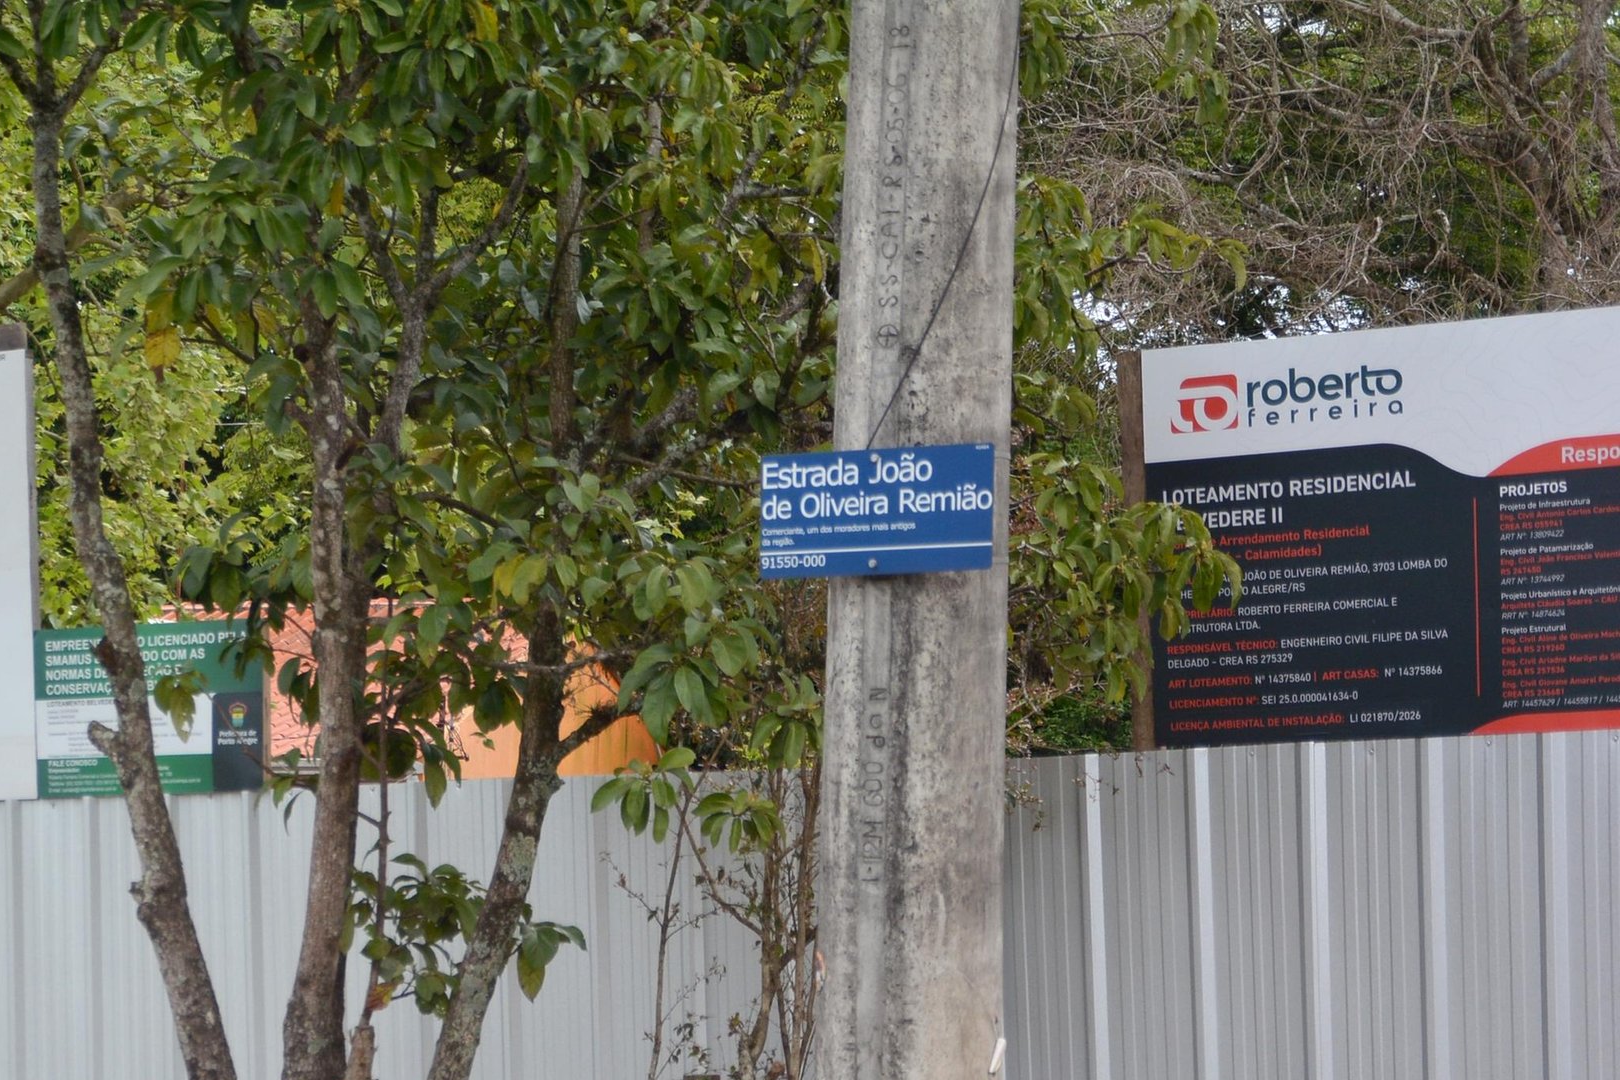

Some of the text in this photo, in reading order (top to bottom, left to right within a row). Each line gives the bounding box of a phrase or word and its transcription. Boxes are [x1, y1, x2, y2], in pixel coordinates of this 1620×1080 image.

[1246, 365, 1403, 408] roberto
[1247, 399, 1403, 428] ferreira
[761, 452, 933, 490] Estrada João
[1162, 470, 1417, 506] LOTEAMENTO RESIDENCIAL
[1499, 481, 1568, 498] PROJETOS
[762, 483, 993, 521] de Oliveira Remião
[1499, 497, 1591, 513] Projeto de Infraestrutura
[1271, 506, 1283, 524] II
[807, 527, 819, 535] um
[820, 525, 832, 534] dos
[834, 523, 870, 533] moradores
[872, 523, 889, 532] mais
[891, 521, 916, 532] antigos
[1219, 523, 1370, 547] Arrendamento Residencial
[1244, 542, 1323, 561] Calamidades)
[1500, 541, 1595, 557] Projeto de Patamarização
[761, 554, 826, 569] 91550-000
[1242, 568, 1268, 583] JOÃO
[1269, 568, 1282, 580] DE
[1284, 566, 1329, 579] OLIVEIRA
[1331, 560, 1370, 576] REMIÃO,
[1373, 561, 1396, 573] 3703
[1398, 559, 1431, 571] LOMBA
[1434, 557, 1448, 569] DO
[1251, 582, 1306, 596] ALEGRE/RS
[1500, 591, 1528, 602] Projeto
[1528, 587, 1572, 600] Urbanístico
[1238, 597, 1398, 617] ROBERTO FERREIRA COMERCIAL E
[1235, 620, 1261, 631] LTDA.
[1501, 623, 1567, 636] Projeto Estrutural
[148, 632, 215, 647] LICENCIADO
[1167, 628, 1449, 656] RESPONSÁVEL TÉCNICO: ENGENHEIRO CIVIL FILIPE DA SILVA
[45, 653, 92, 667] SMAMUS
[161, 648, 187, 661] COM
[189, 647, 206, 660] AS
[1167, 652, 1294, 670] DELGADO CREA RS 275329
[45, 668, 92, 681] NORMAS
[1168, 678, 1186, 690] ART
[1189, 675, 1252, 689] LOTEAMENTO:
[1268, 671, 1312, 684] 14375840
[1322, 669, 1342, 682] ART
[1398, 664, 1443, 678] 14375866
[46, 682, 112, 696] CONSERVAÇ
[1169, 696, 1247, 710] LICENCIAMENTO
[1261, 694, 1277, 705] SEI
[1170, 720, 1210, 735] LICENÇA
[1212, 716, 1265, 730] AMBIENTAL
[1267, 715, 1281, 728] DE
[1349, 712, 1359, 724] LI
[1360, 710, 1421, 724] 021870/2026
